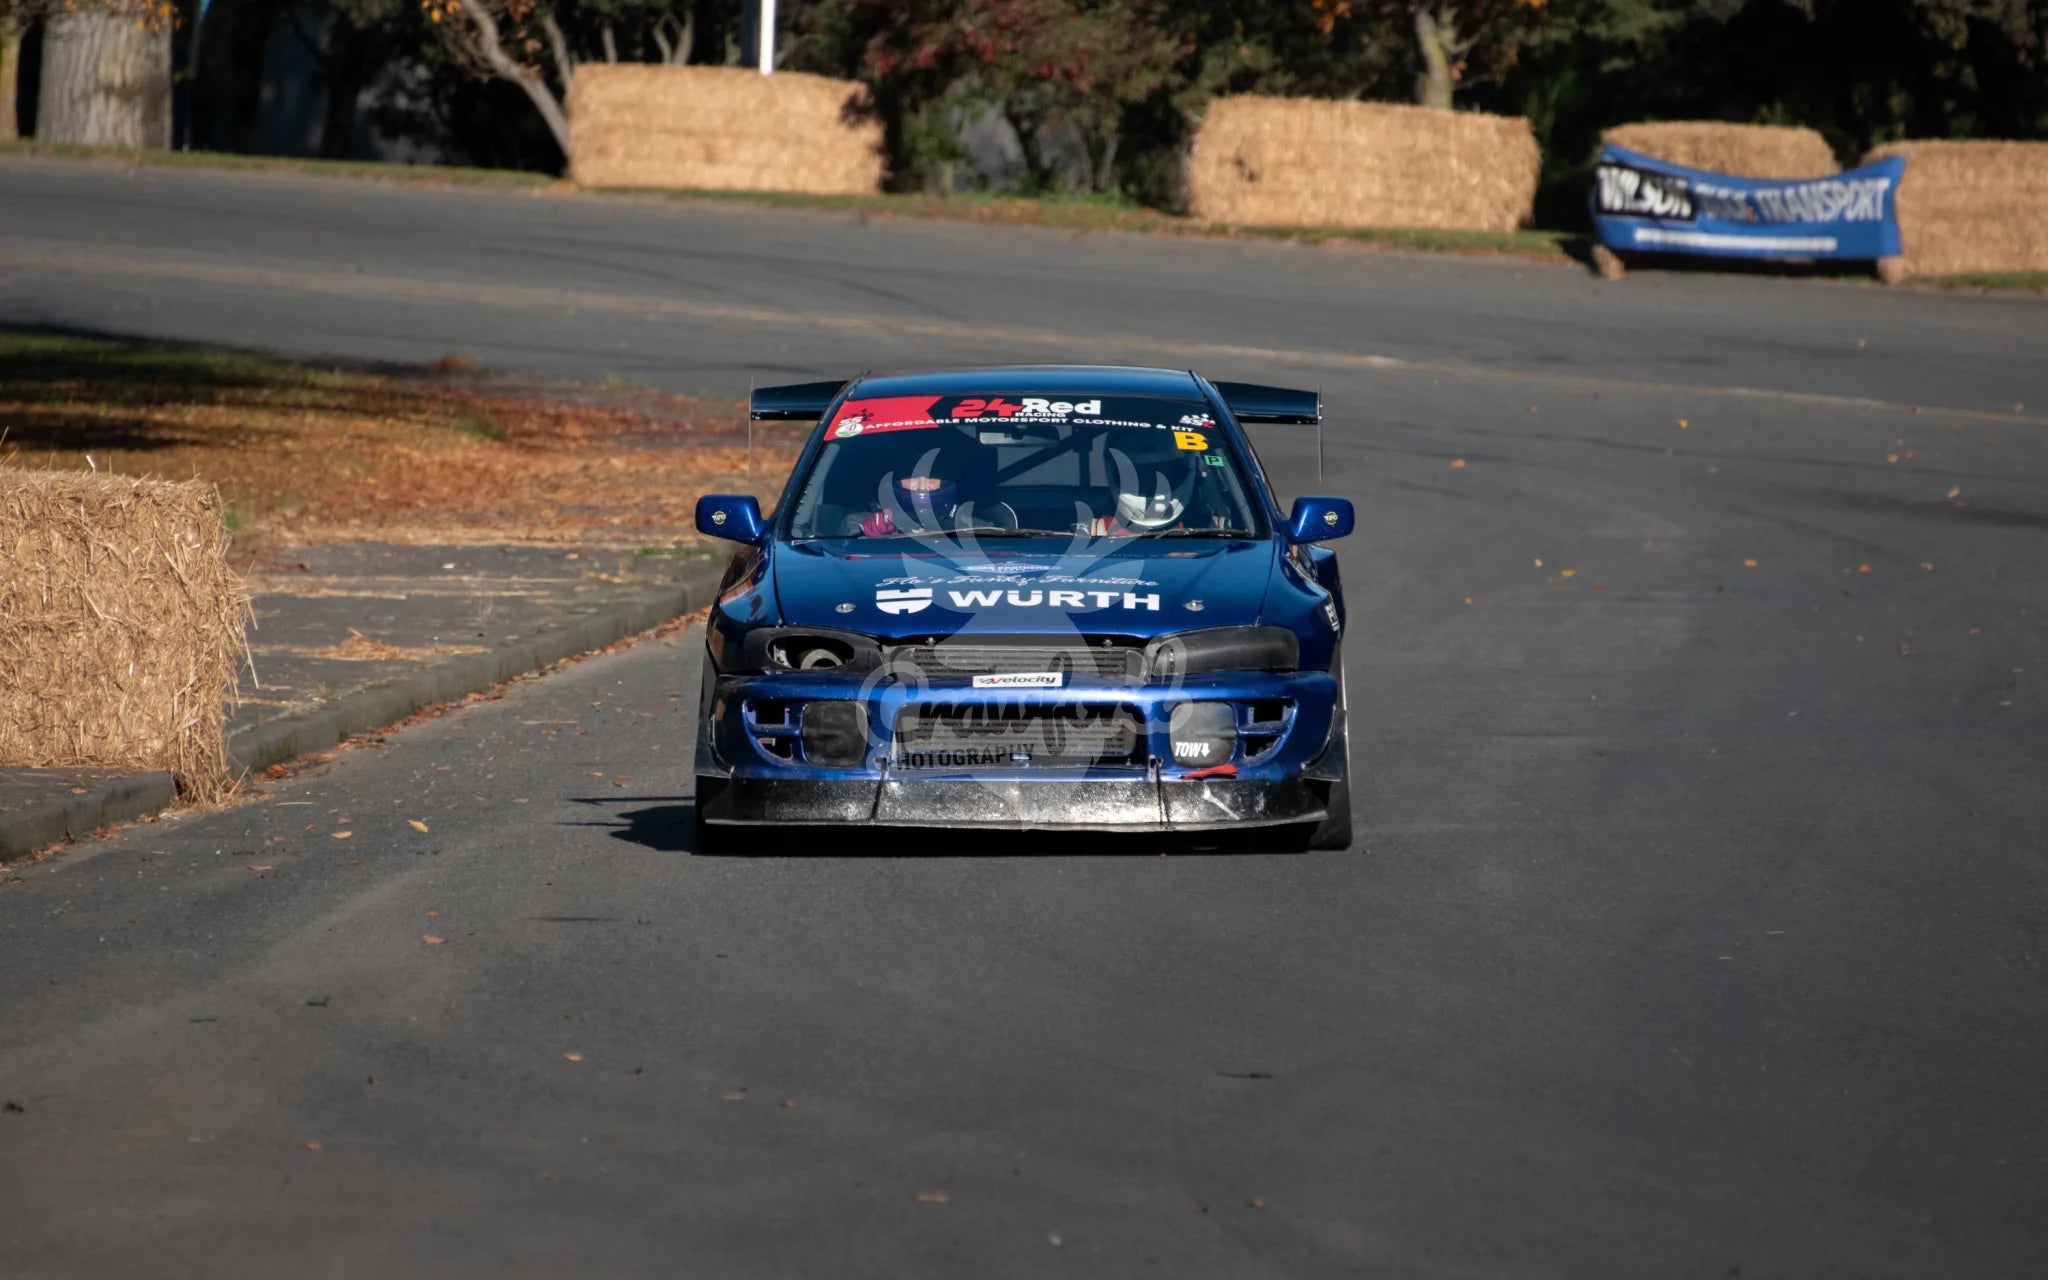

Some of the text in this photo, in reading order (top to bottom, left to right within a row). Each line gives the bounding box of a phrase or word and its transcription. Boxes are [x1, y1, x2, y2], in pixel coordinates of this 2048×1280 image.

[1754, 178, 1891, 222] TRANSPORT
[865, 418, 960, 429] AFFORDABLE
[1073, 418, 1152, 428] CLOTHING
[1173, 431, 1208, 451] B
[948, 590, 1160, 611] WÜRTH
[1174, 741, 1201, 757] TOW
